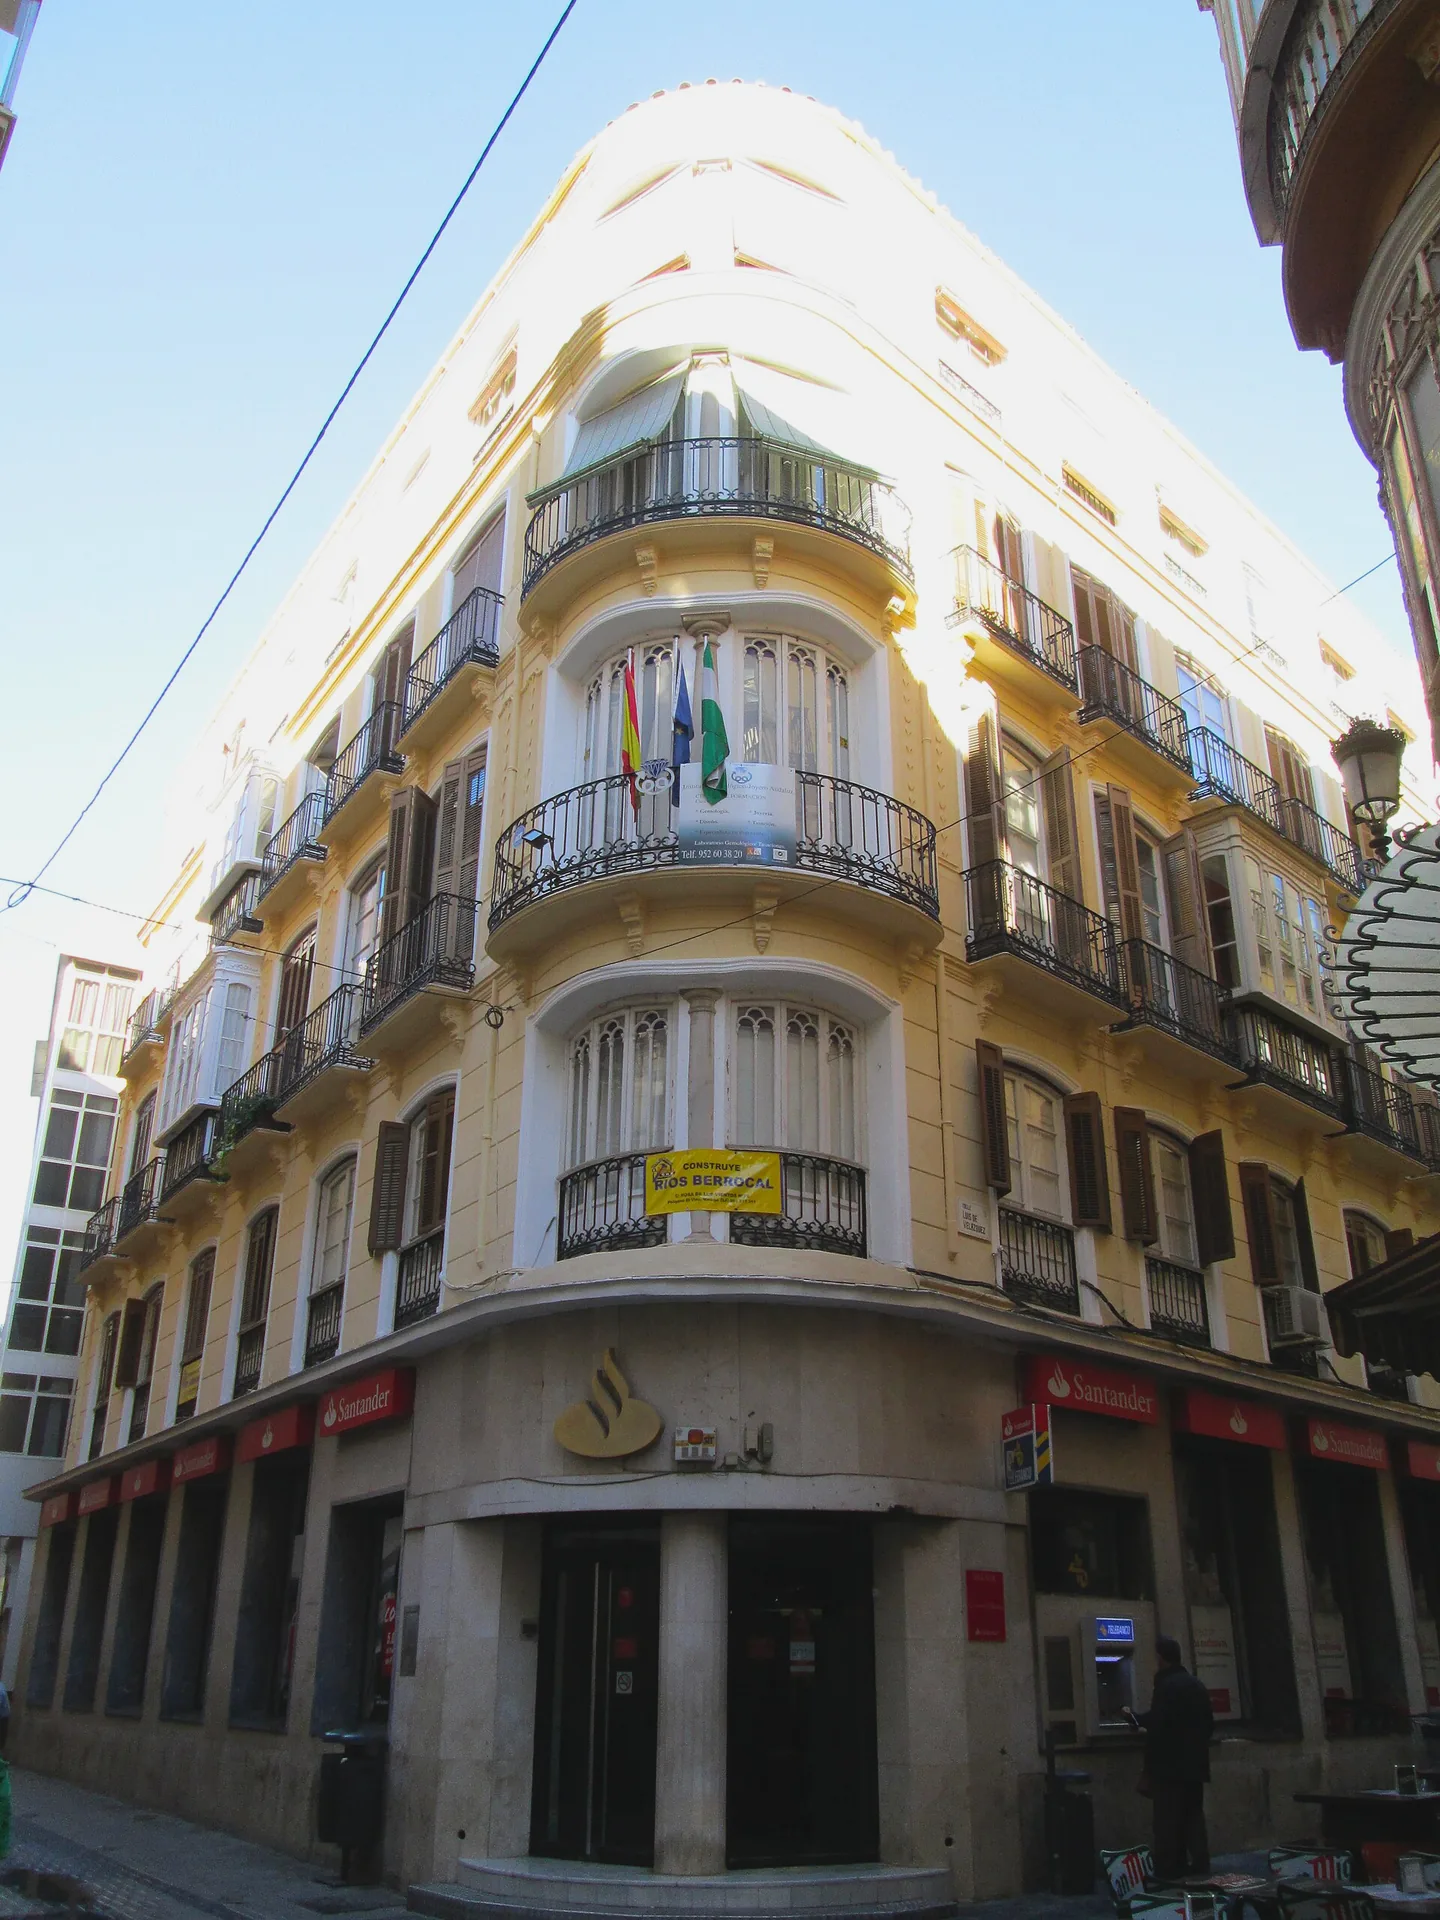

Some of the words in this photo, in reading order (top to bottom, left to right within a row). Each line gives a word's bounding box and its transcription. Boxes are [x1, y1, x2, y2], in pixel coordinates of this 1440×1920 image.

[681, 850, 698, 859] Telf.
[698, 850, 712, 859] 952
[713, 850, 723, 859] 60
[724, 850, 733, 859] 38
[733, 850, 743, 859] 20
[683, 1162, 741, 1171] CONSTRUYE
[692, 1175, 774, 1189] BERROCAL
[337, 1384, 391, 1422] Santander
[1073, 1373, 1155, 1414] Santander
[1329, 1431, 1385, 1462] Santander
